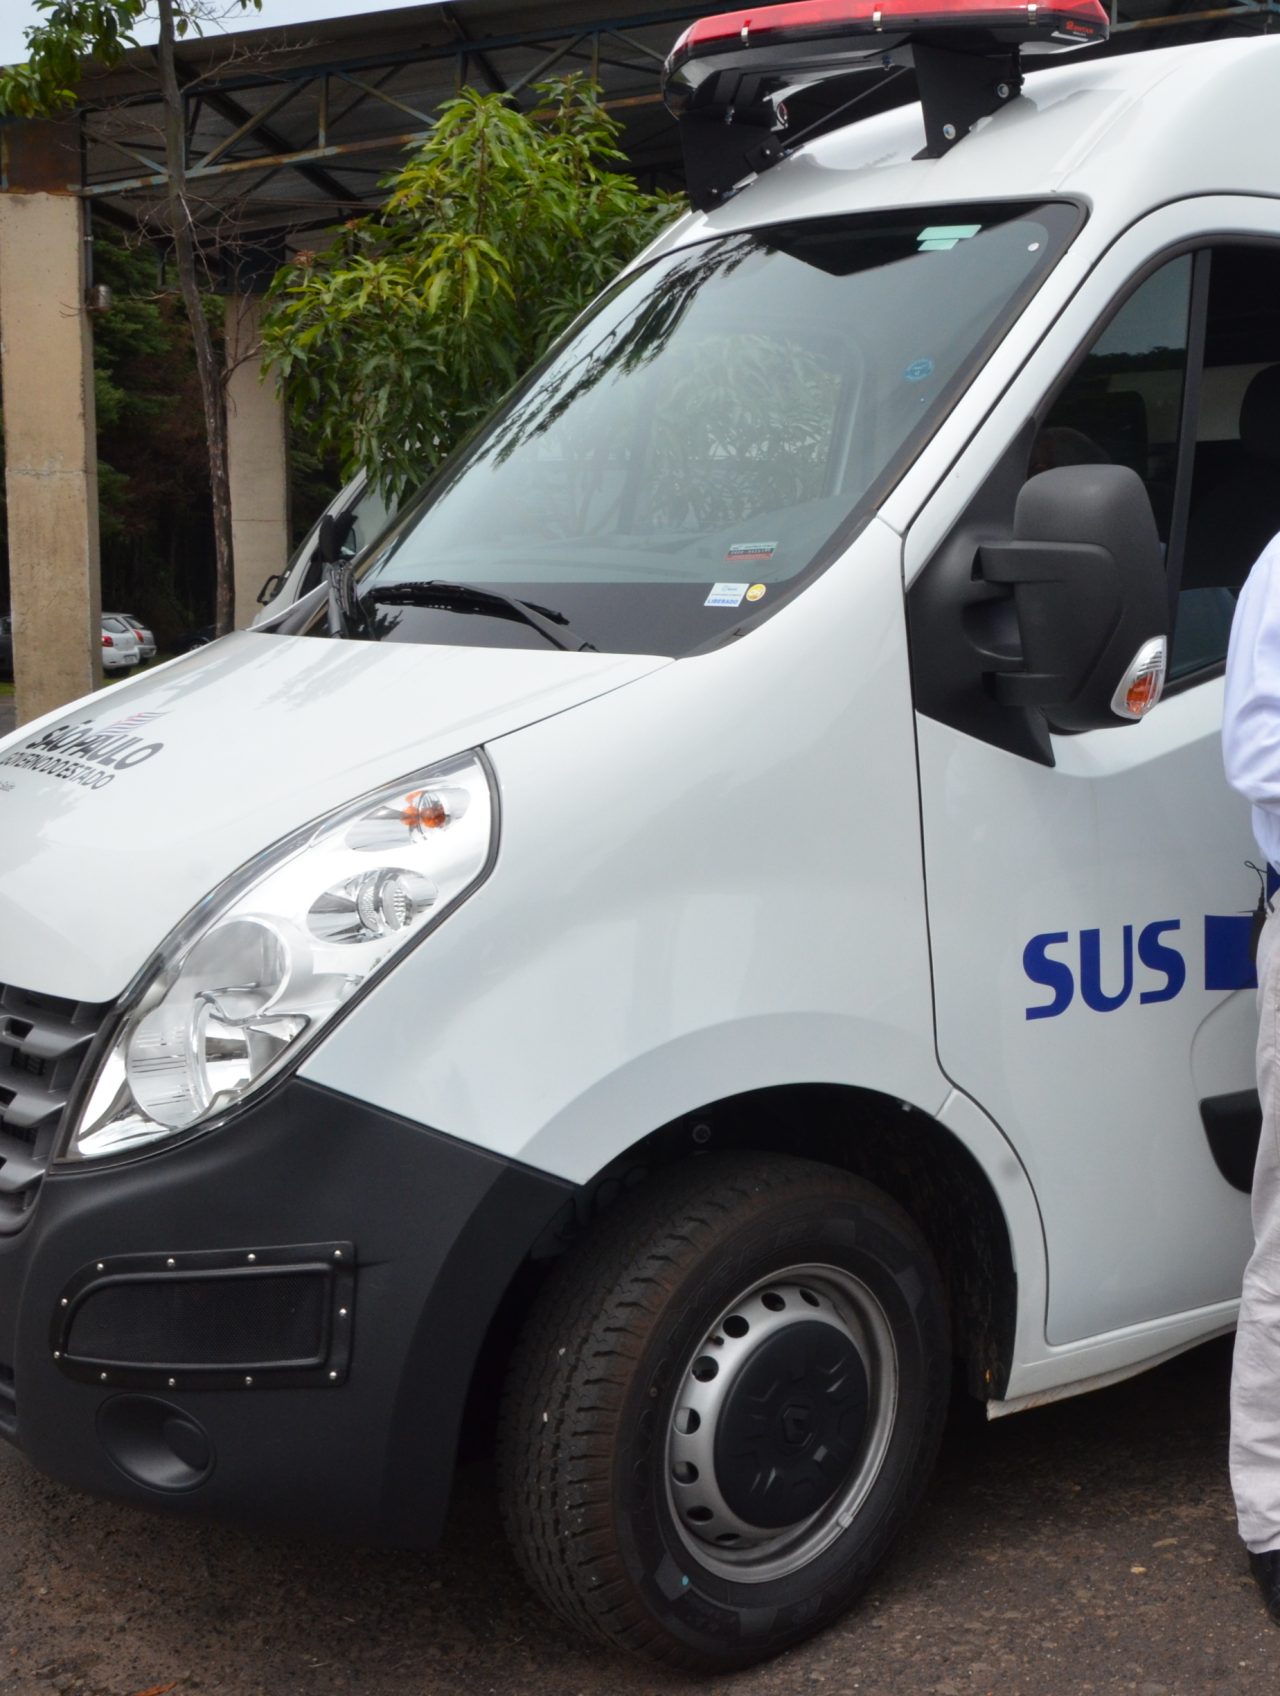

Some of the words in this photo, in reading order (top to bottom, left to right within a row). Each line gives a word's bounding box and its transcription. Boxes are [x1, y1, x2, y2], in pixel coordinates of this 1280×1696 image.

[25, 720, 94, 752] SÃO
[60, 734, 164, 770] PAULO
[55, 762, 115, 790] ESTADO
[1023, 919, 1186, 1020] SUS
